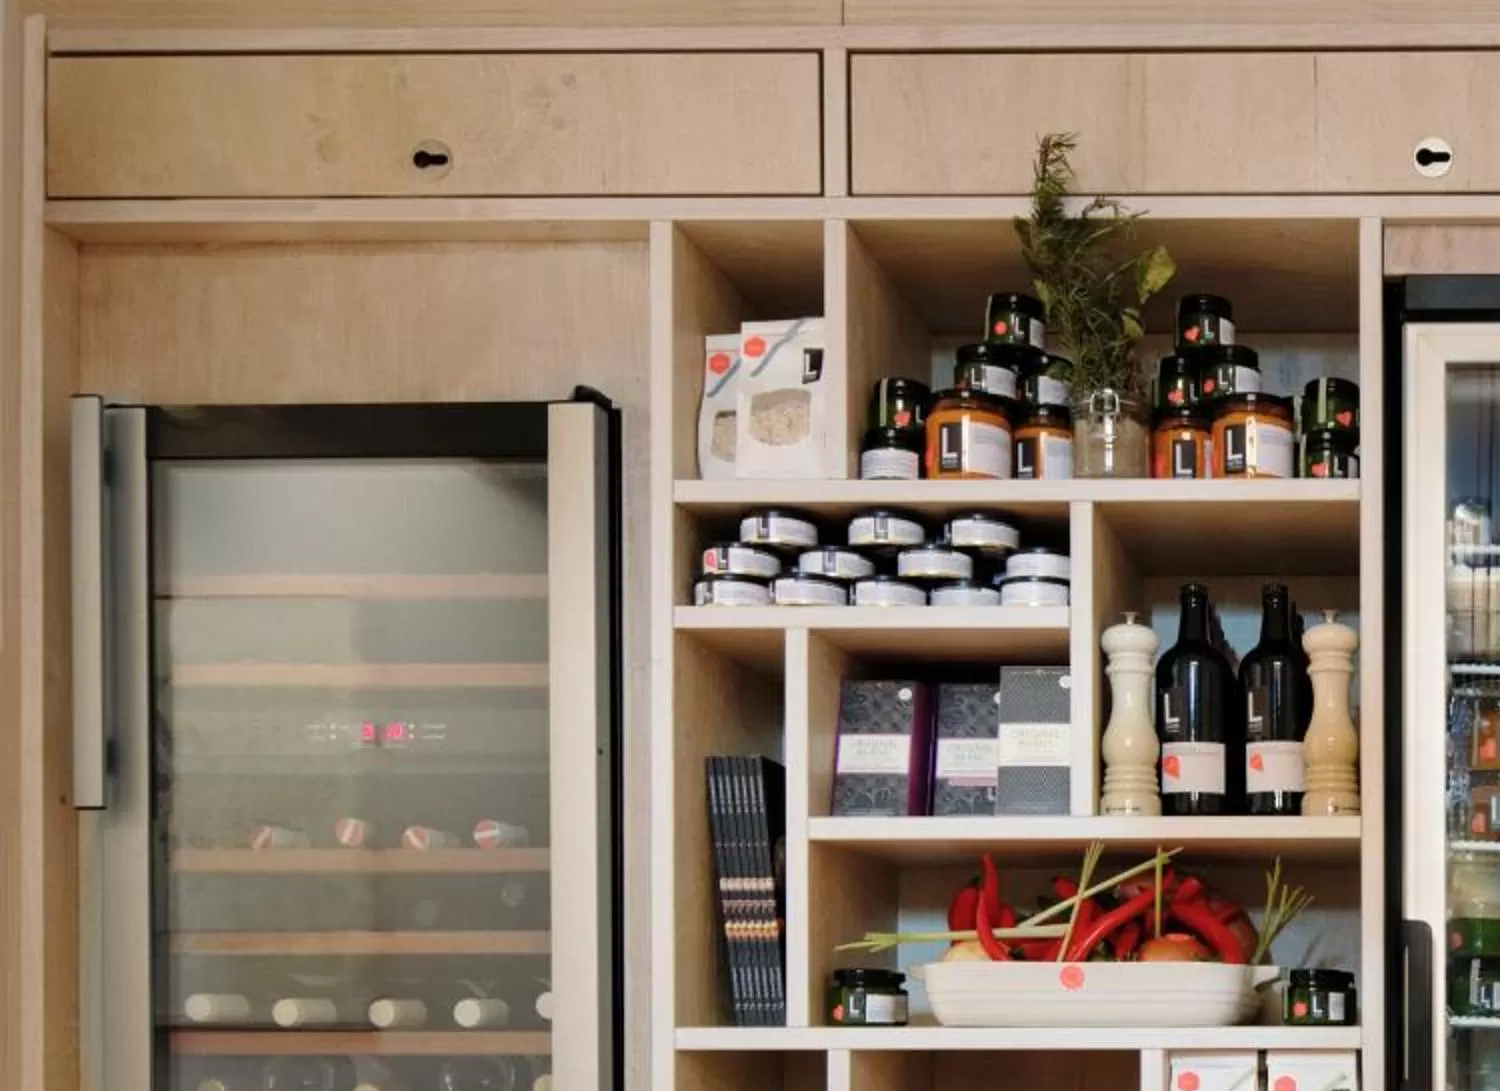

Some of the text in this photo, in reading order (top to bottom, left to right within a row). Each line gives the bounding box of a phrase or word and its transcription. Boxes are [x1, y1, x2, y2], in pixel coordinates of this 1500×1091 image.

[804, 353, 817, 377] L
[941, 428, 957, 457] L
[1019, 442, 1032, 472] L
[1227, 429, 1243, 460] L
[1176, 444, 1192, 473] L
[1164, 693, 1180, 722] L
[1248, 692, 1263, 722] L
